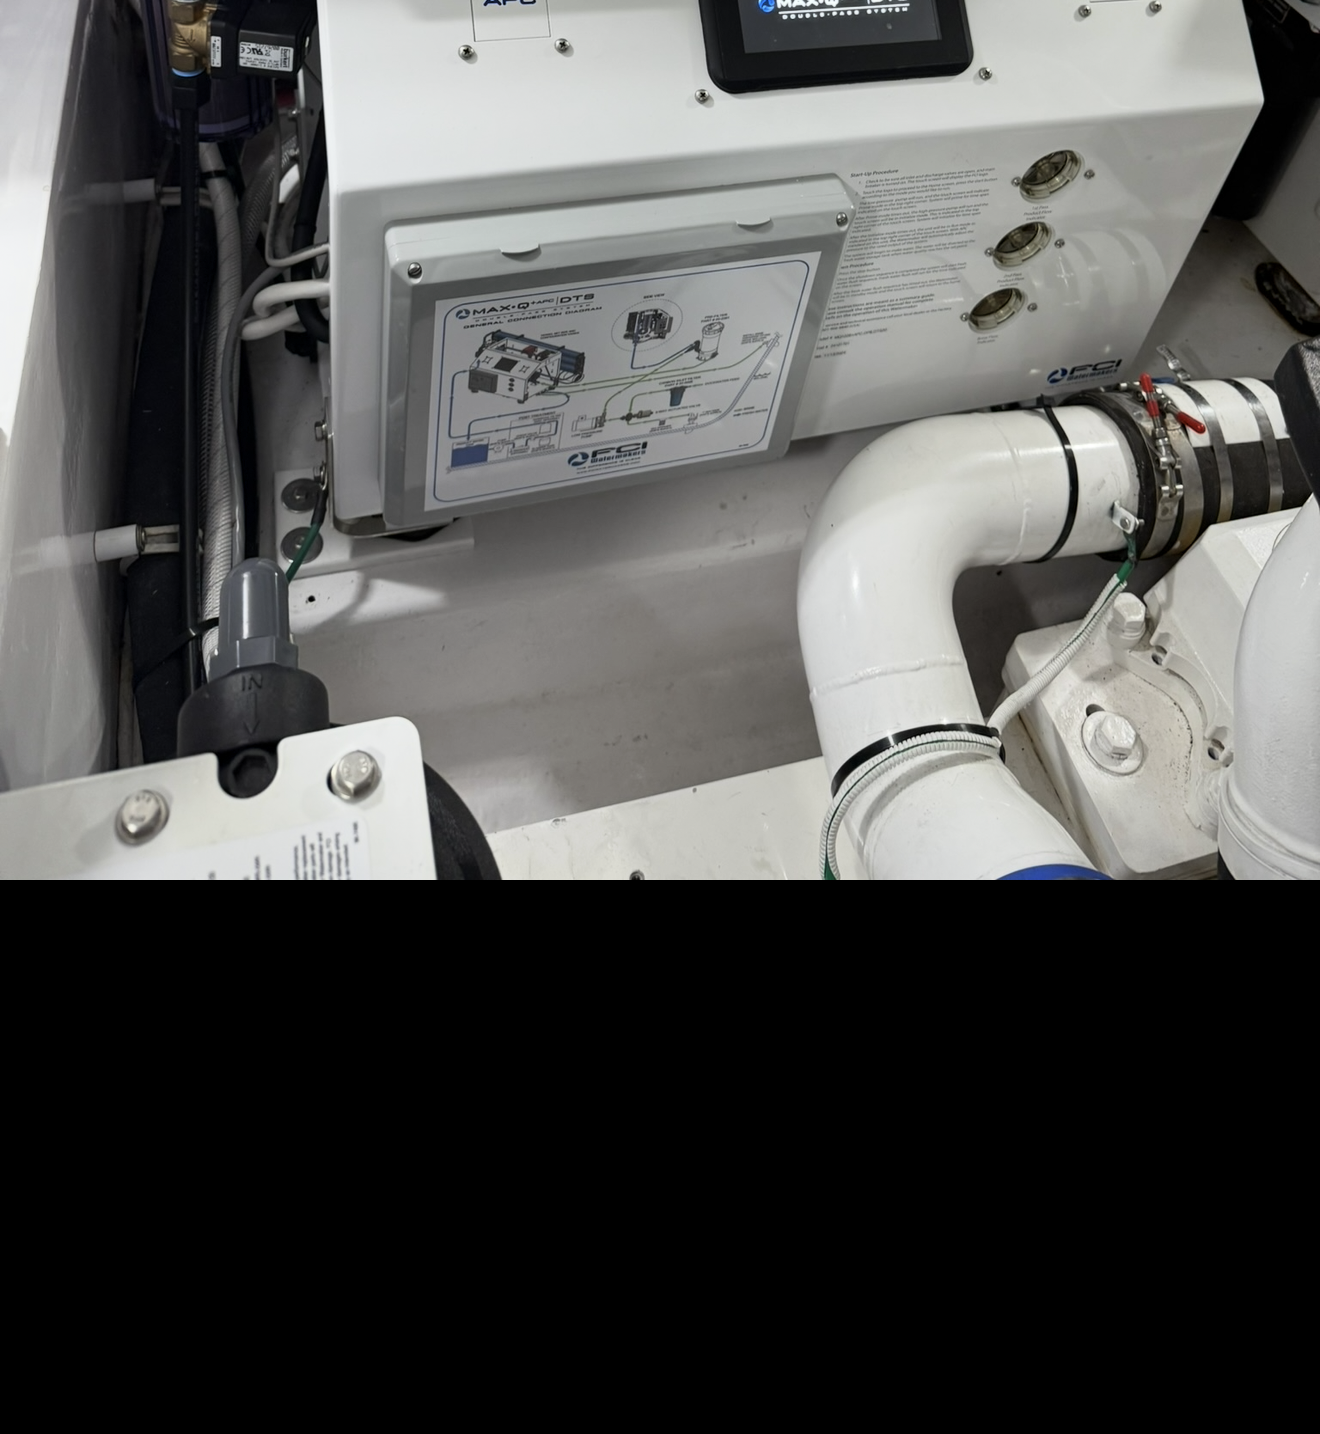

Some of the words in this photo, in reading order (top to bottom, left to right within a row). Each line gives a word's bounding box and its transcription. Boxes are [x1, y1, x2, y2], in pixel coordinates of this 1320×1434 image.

[463, 320, 504, 329] GENERAL
[507, 312, 562, 323] CONNECTION
[565, 306, 602, 315] DIAGRAM
[1066, 367, 1118, 381] Watermakers
[1069, 358, 1123, 375] FCI
[590, 449, 646, 463] Watermakers
[591, 441, 648, 458] FCI
[240, 674, 264, 692] IN
